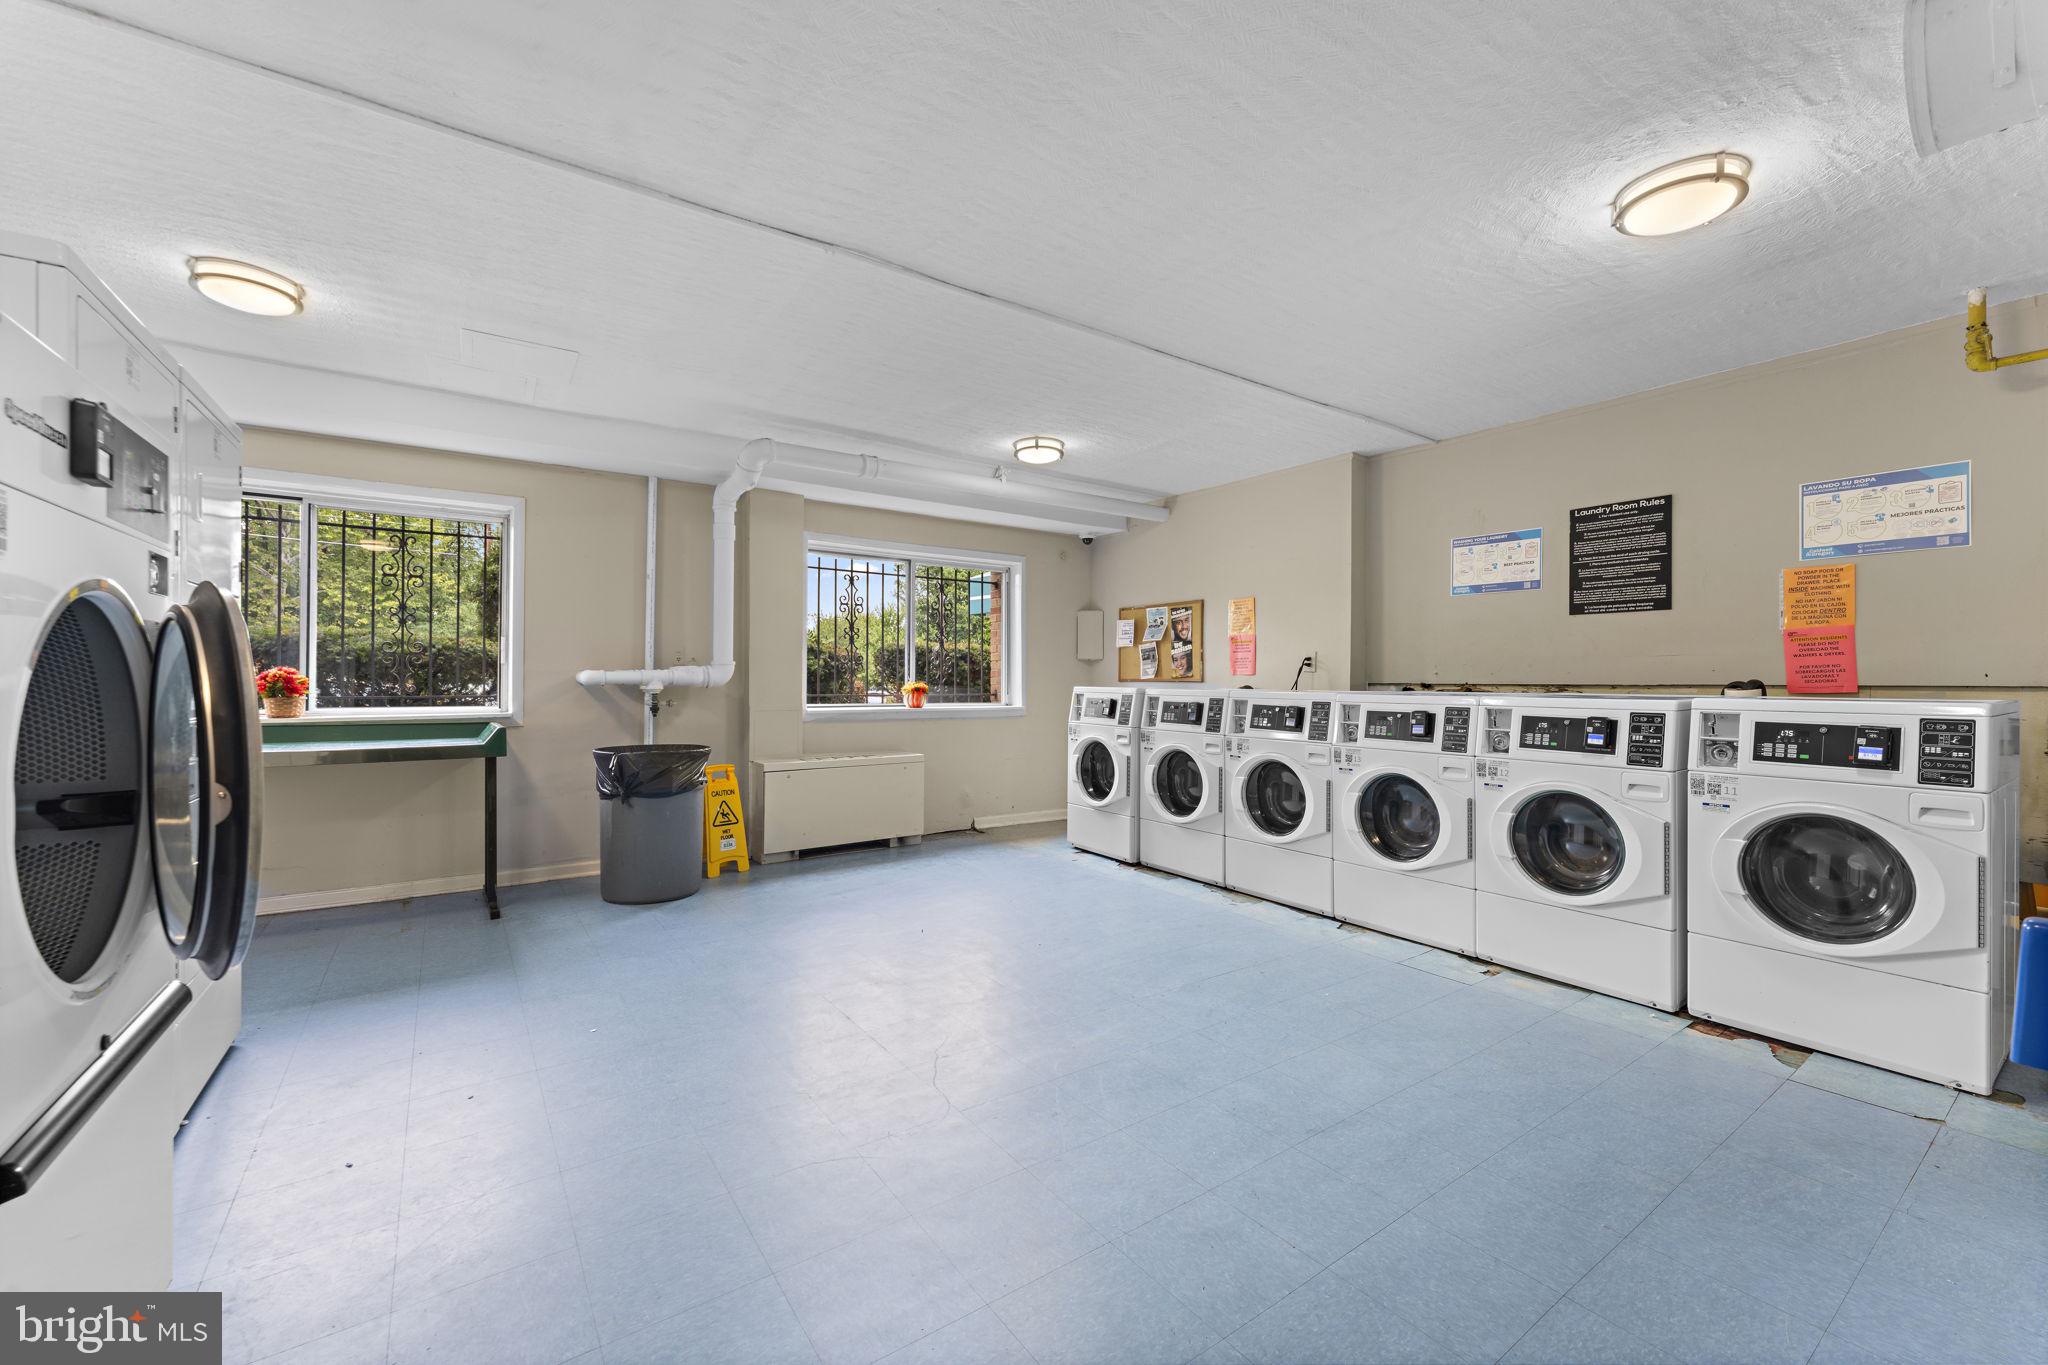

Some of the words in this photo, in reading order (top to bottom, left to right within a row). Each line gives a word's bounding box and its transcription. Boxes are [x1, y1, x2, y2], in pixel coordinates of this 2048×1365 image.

[1804, 483, 1840, 491] LAVANDO
[1574, 507, 1611, 517] Laundry
[1612, 503, 1638, 511] Room
[1640, 499, 1665, 507] Rules
[711, 789, 735, 797] CAUTION
